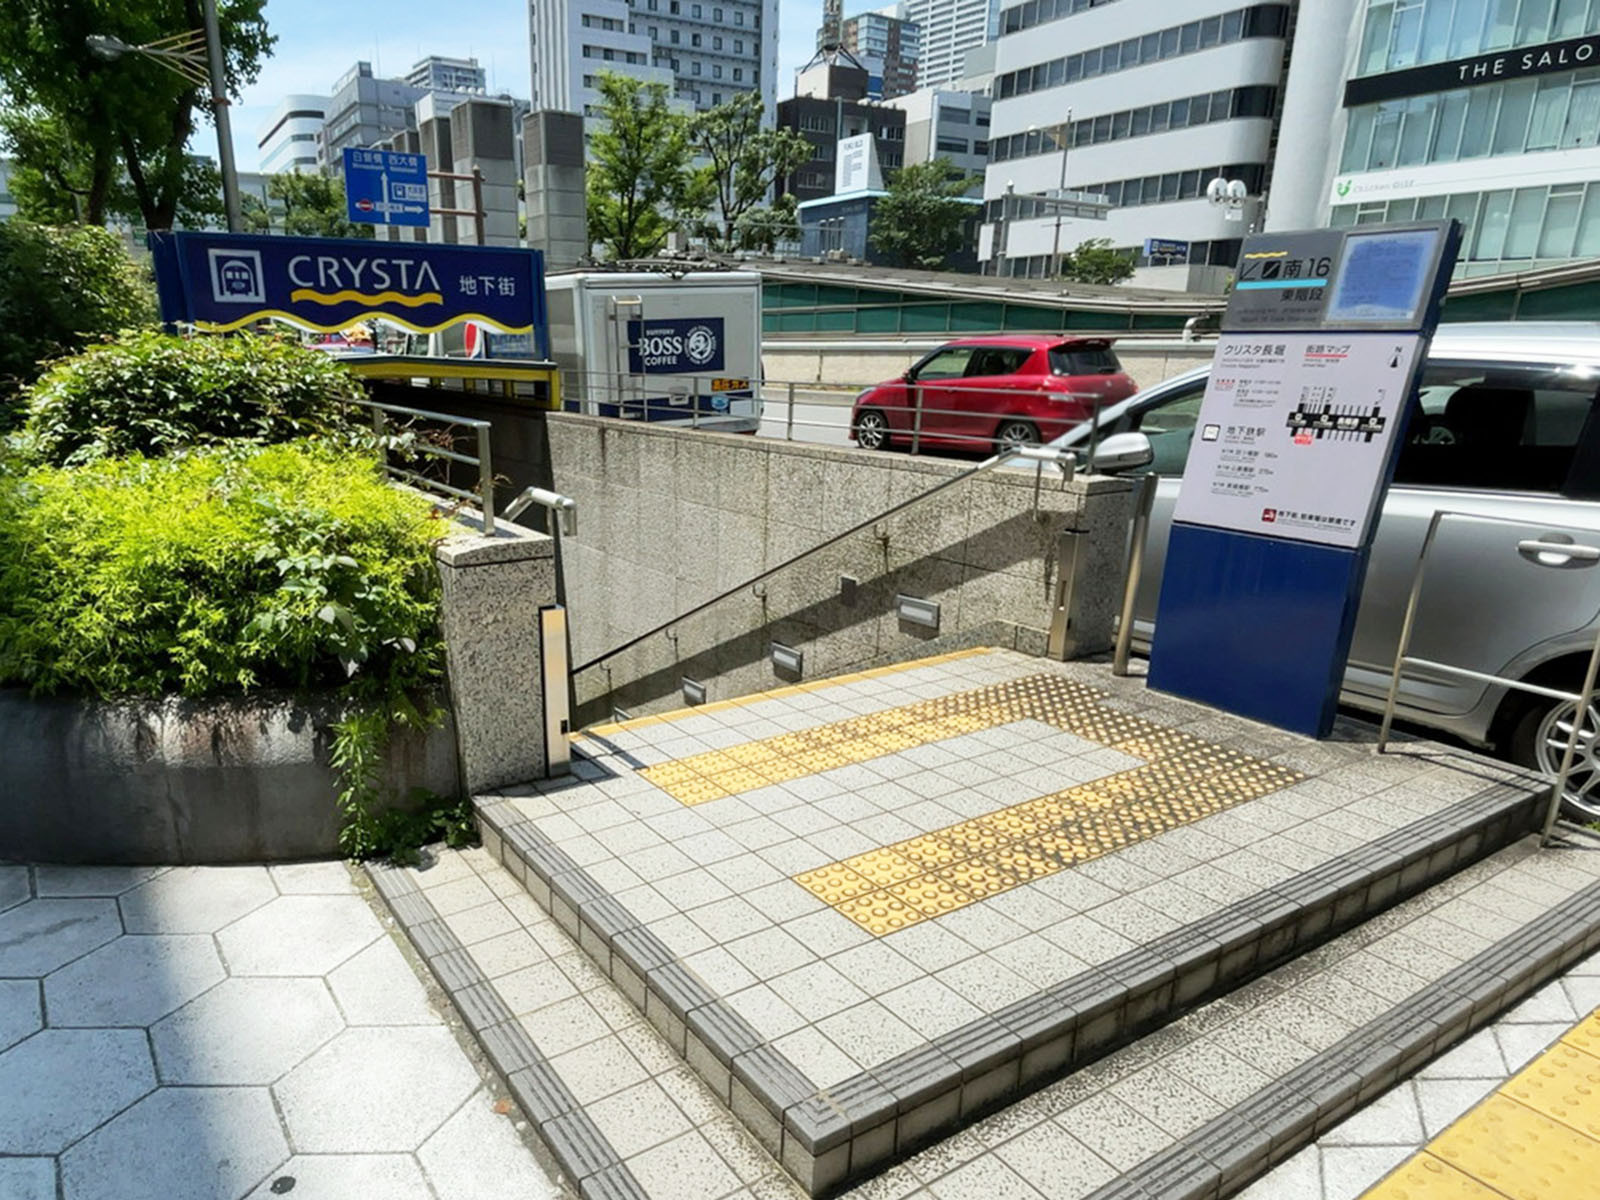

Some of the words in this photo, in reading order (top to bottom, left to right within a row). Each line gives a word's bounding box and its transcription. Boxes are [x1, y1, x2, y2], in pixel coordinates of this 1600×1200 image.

[1458, 58, 1506, 80] THE
[1520, 43, 1600, 71] SALO
[288, 255, 440, 291] CRYSTA
[458, 275, 516, 297] 地下街
[639, 336, 682, 356] BOSS
[645, 356, 677, 366] COFFEE
